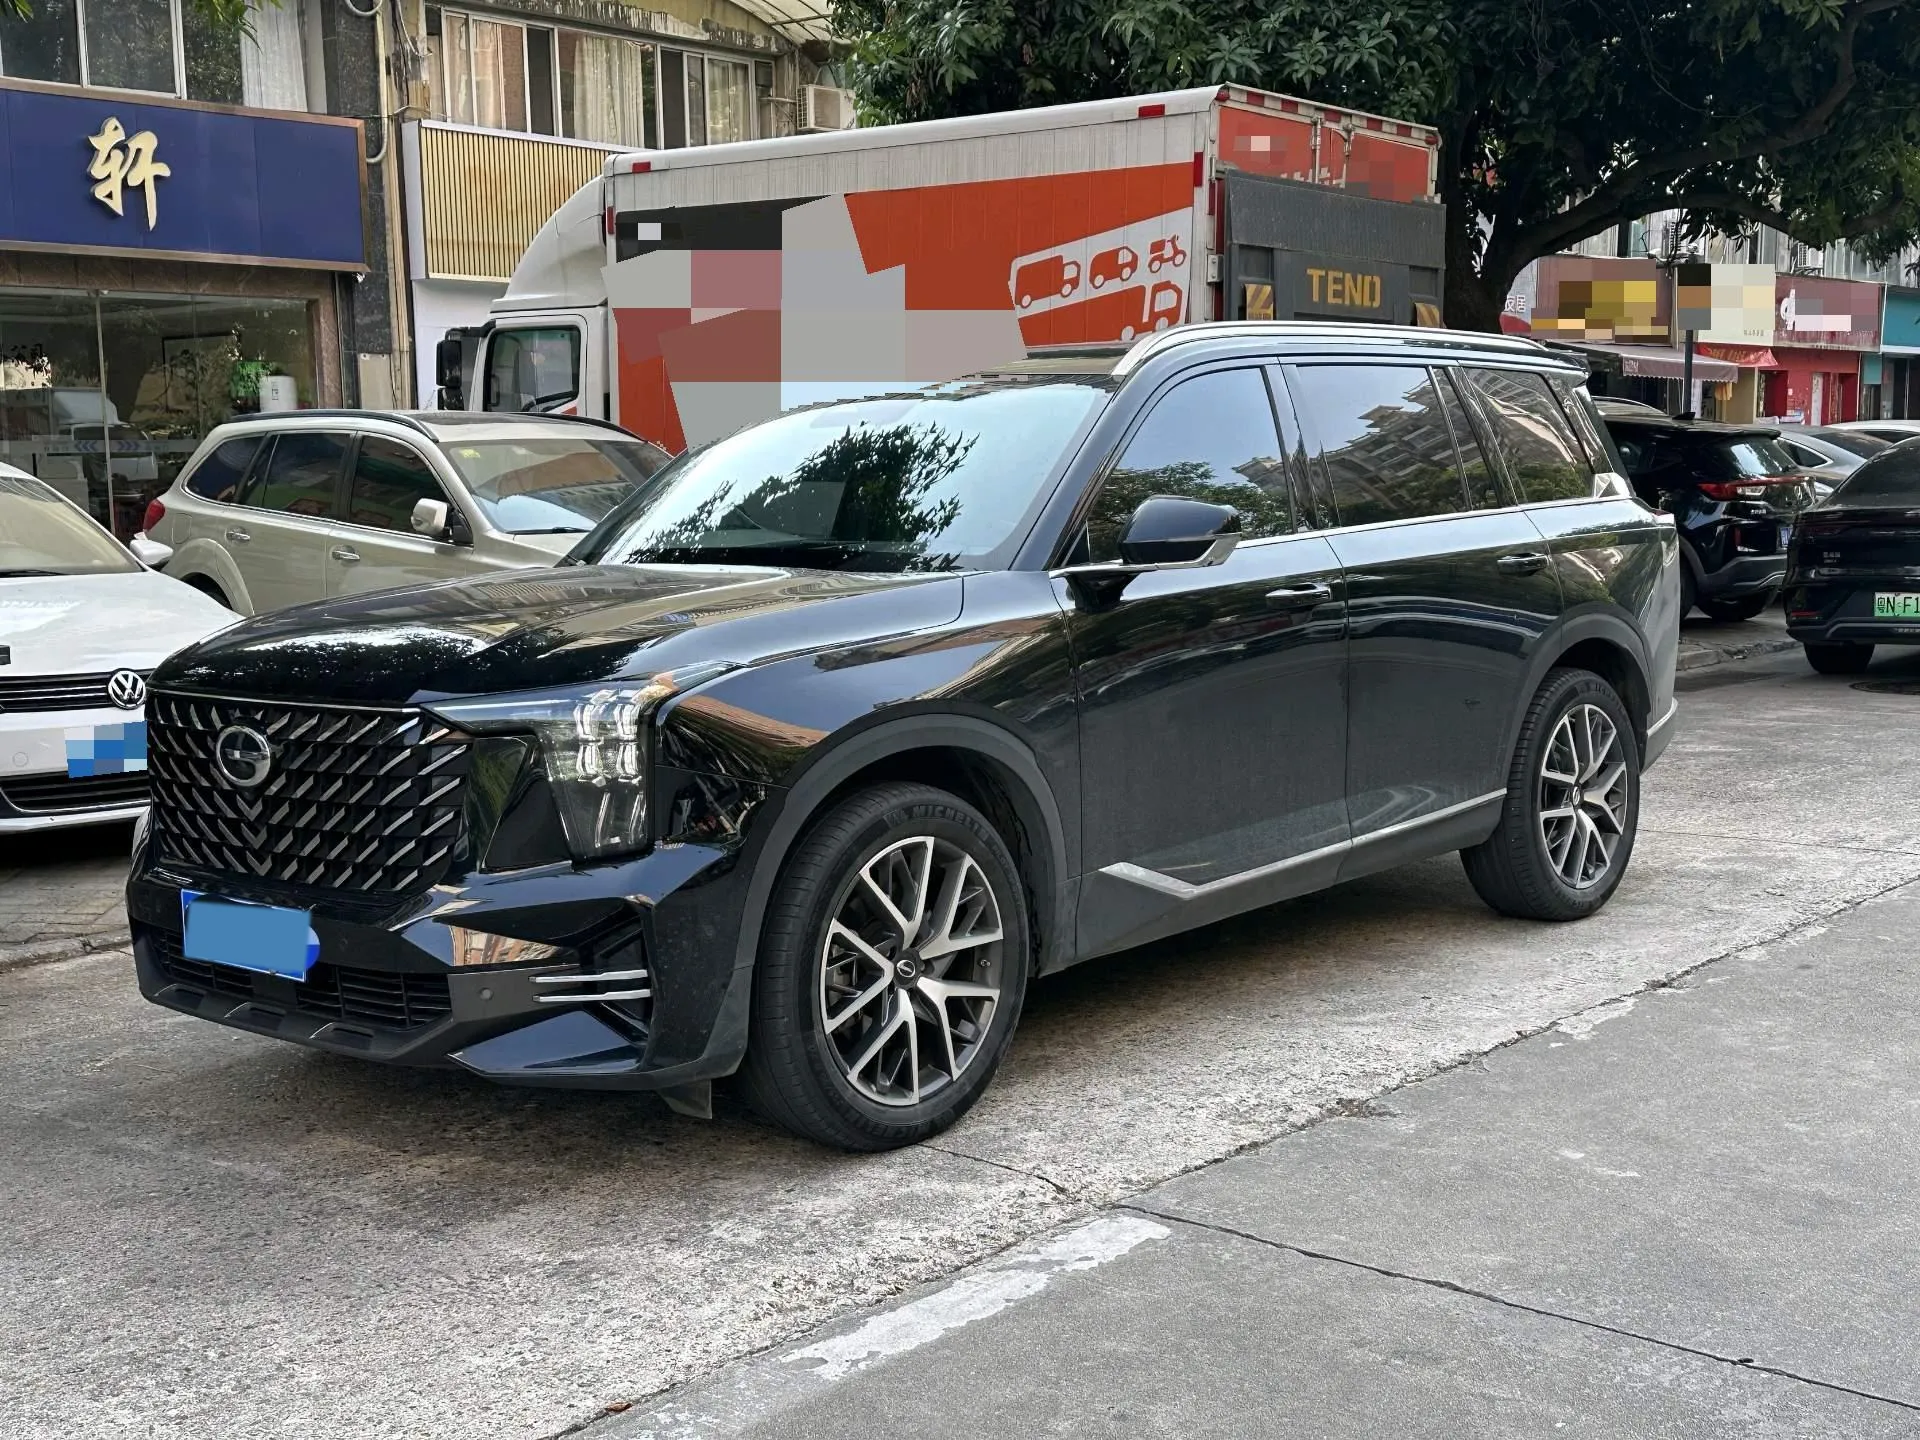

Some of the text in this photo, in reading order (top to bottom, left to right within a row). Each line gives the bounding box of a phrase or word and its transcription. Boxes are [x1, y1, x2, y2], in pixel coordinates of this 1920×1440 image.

[87, 116, 171, 232] 轩
[1306, 268, 1381, 308] TEND
[912, 805, 991, 842] MICHELIN
